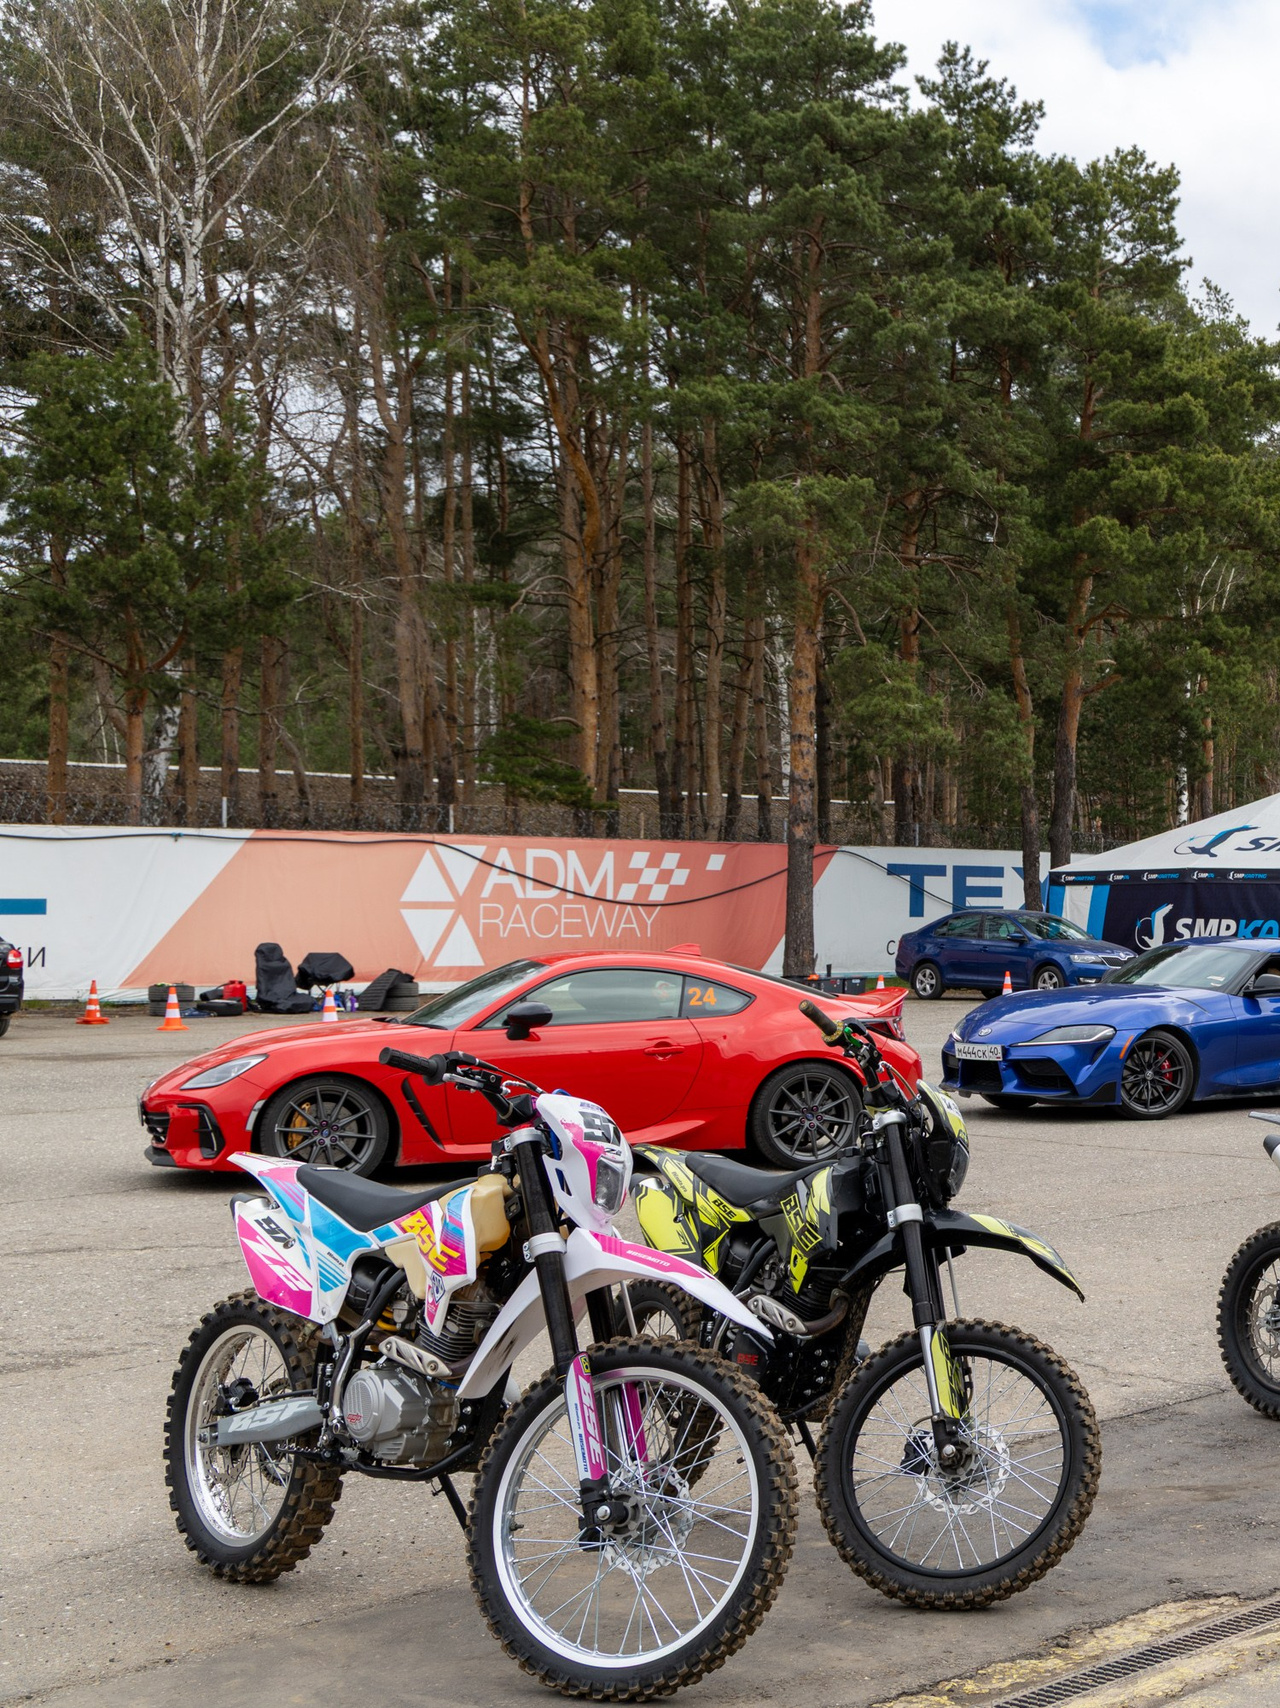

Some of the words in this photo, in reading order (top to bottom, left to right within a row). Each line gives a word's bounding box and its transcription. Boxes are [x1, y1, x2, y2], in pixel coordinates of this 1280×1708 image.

[480, 847, 615, 900] ADM
[479, 903, 662, 938] RACEWAY
[687, 986, 718, 1006] 24
[711, 1197, 737, 1220] BSE
[400, 1210, 461, 1274] BSE
[737, 1352, 759, 1366] BSE
[578, 1374, 606, 1472] BSE
